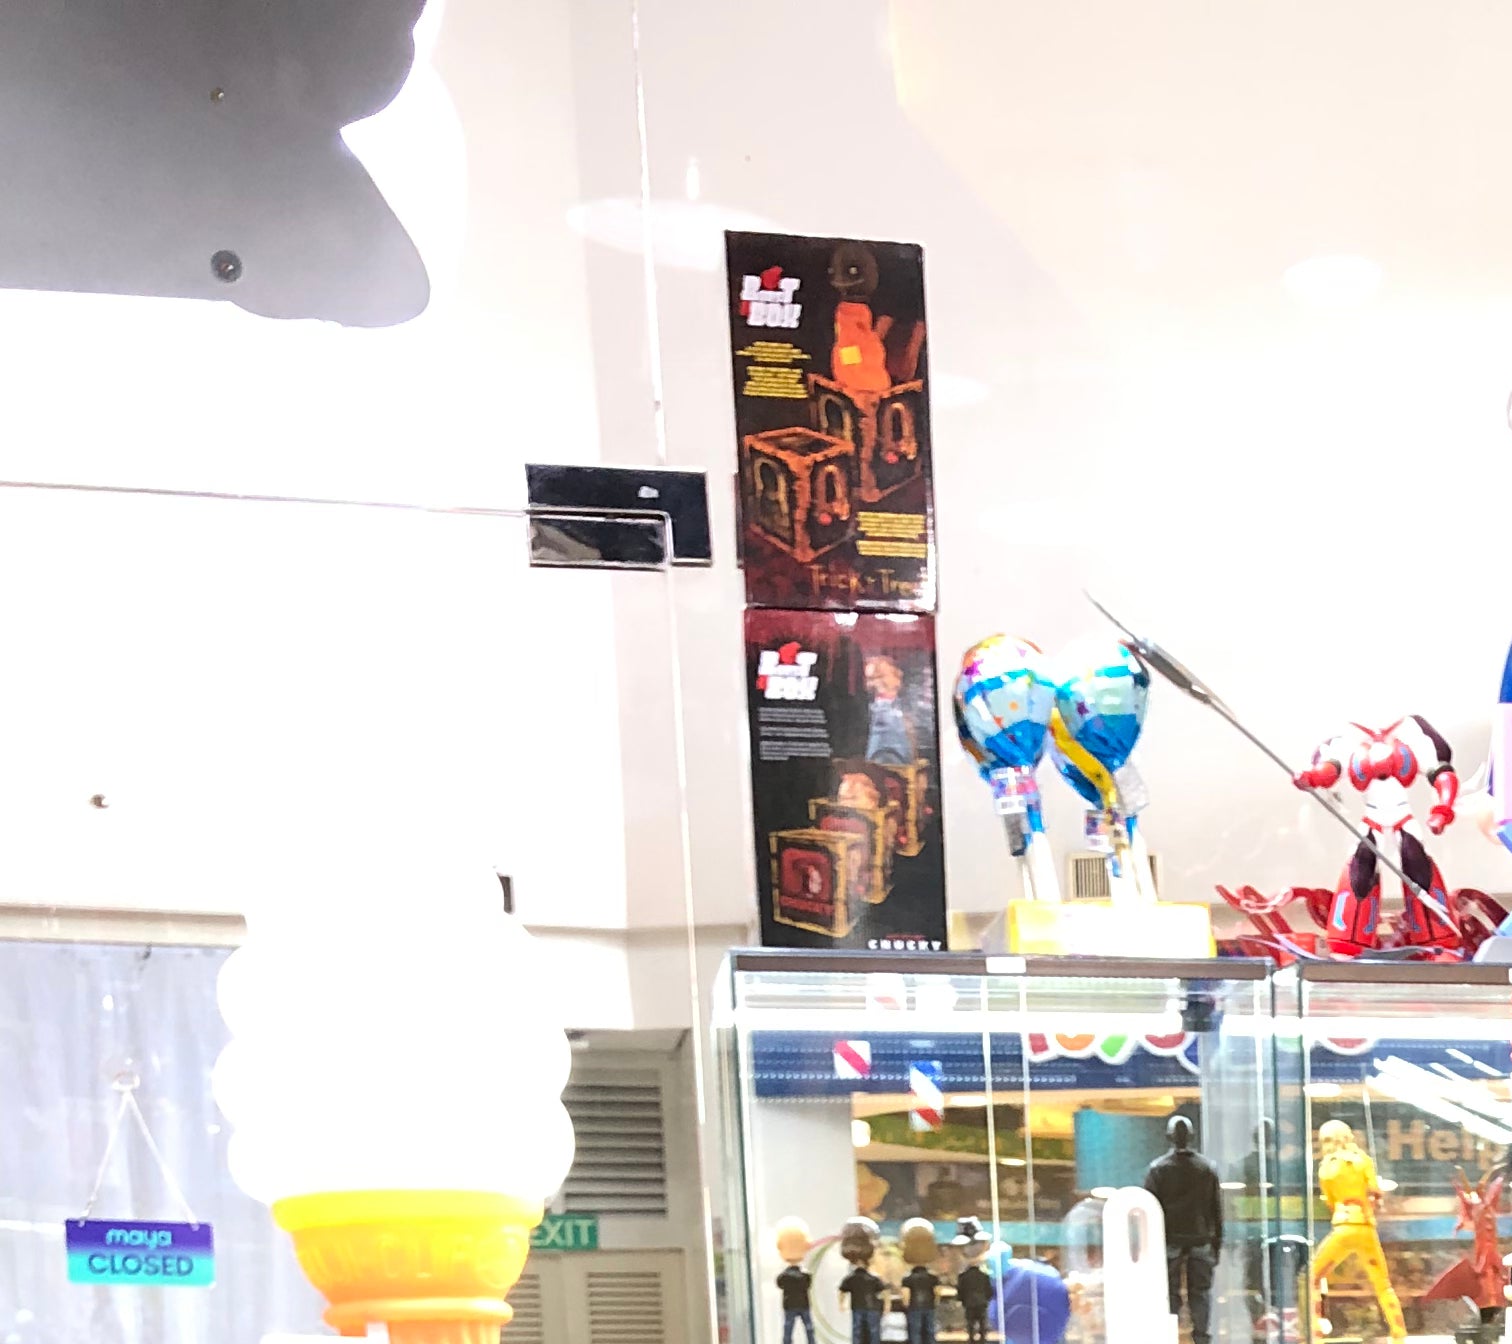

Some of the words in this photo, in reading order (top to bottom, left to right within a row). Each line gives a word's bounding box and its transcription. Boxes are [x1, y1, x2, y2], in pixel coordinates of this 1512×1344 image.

[867, 938, 943, 951] CHUCKY
[106, 1228, 172, 1250] maya
[88, 1253, 194, 1276] CLOSED
